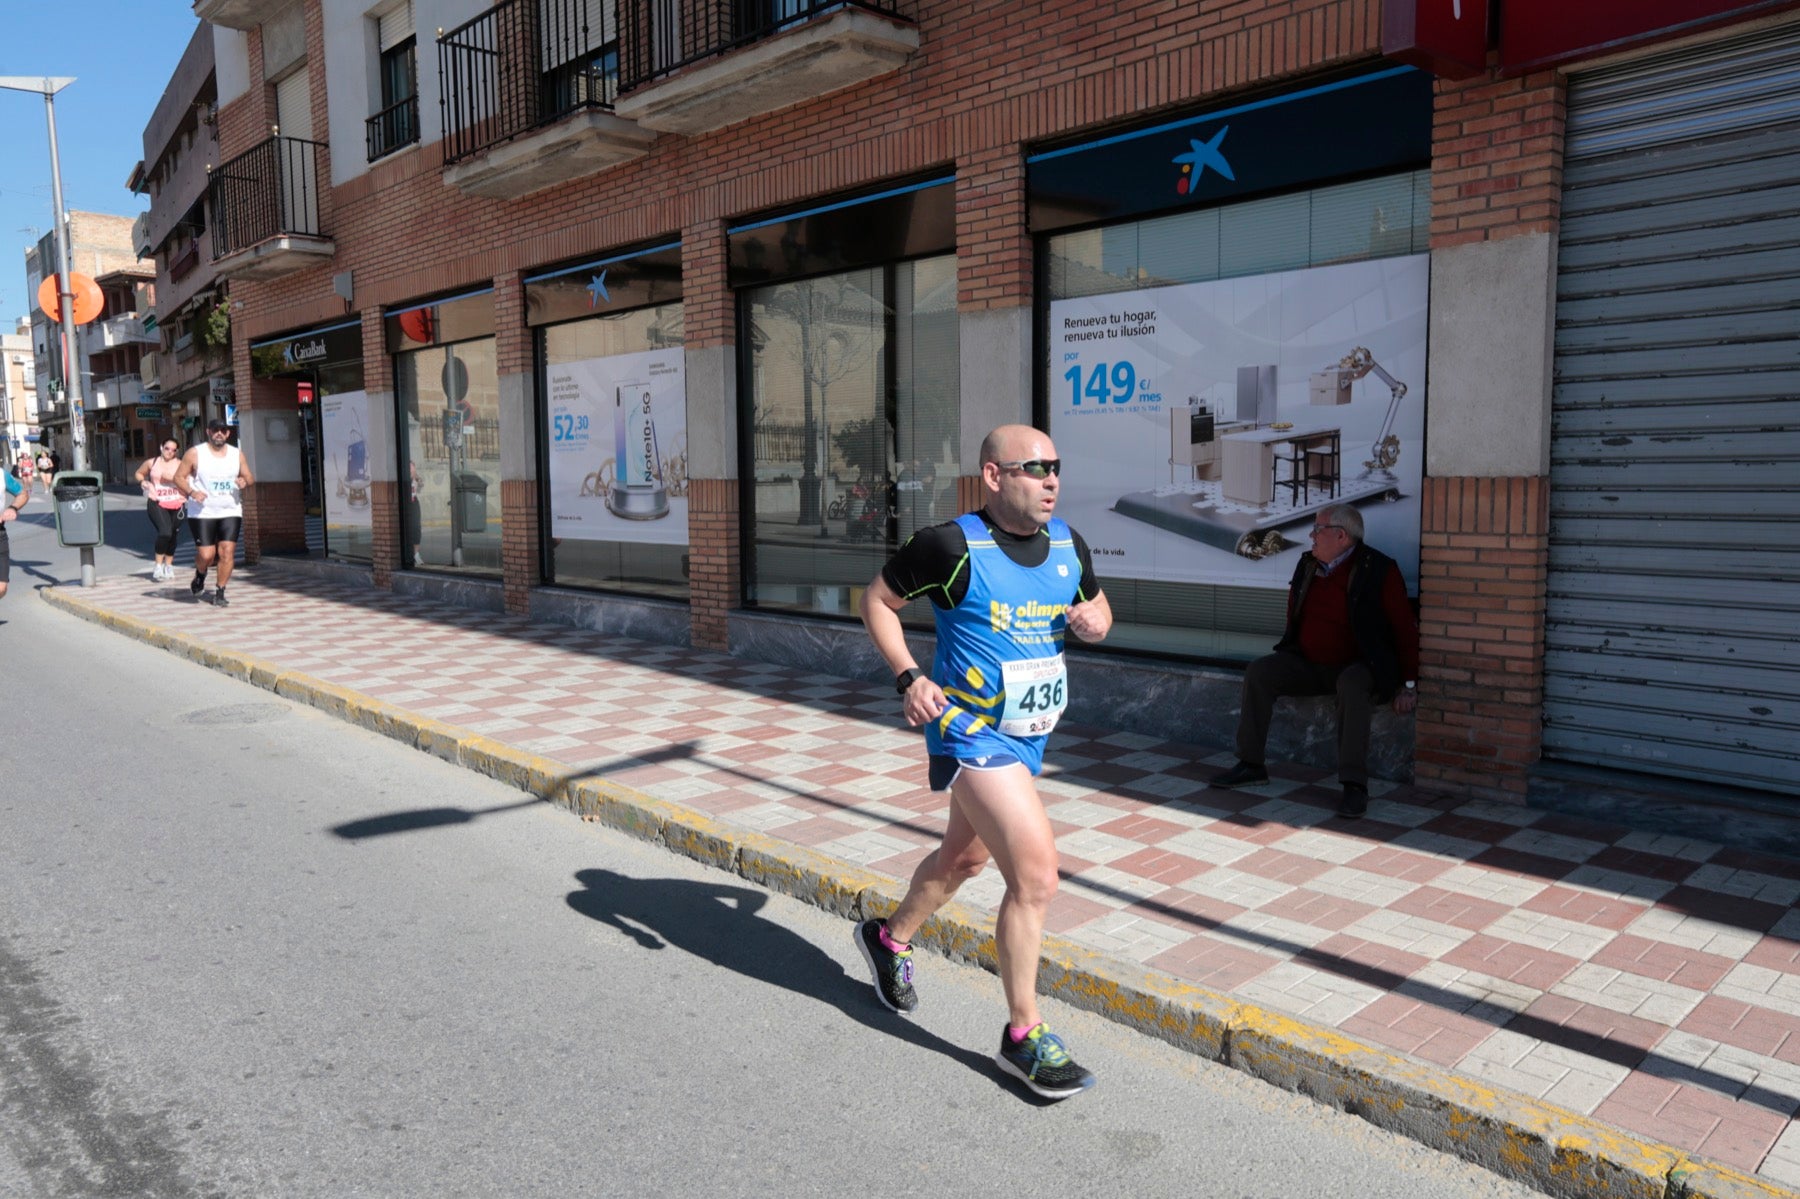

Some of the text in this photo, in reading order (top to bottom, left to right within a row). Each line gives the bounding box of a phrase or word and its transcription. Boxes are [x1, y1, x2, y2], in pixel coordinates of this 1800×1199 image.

[1064, 310, 1157, 329] Renueva tu hogar,
[1064, 322, 1155, 342] renueva tu ilusión
[294, 338, 327, 361] CaixaBank
[1064, 352, 1079, 363] por
[1064, 360, 1136, 406] 149
[1139, 392, 1162, 403] mes
[213, 481, 231, 491] 755
[1110, 548, 1125, 556] vida
[1018, 678, 1063, 713] 436
